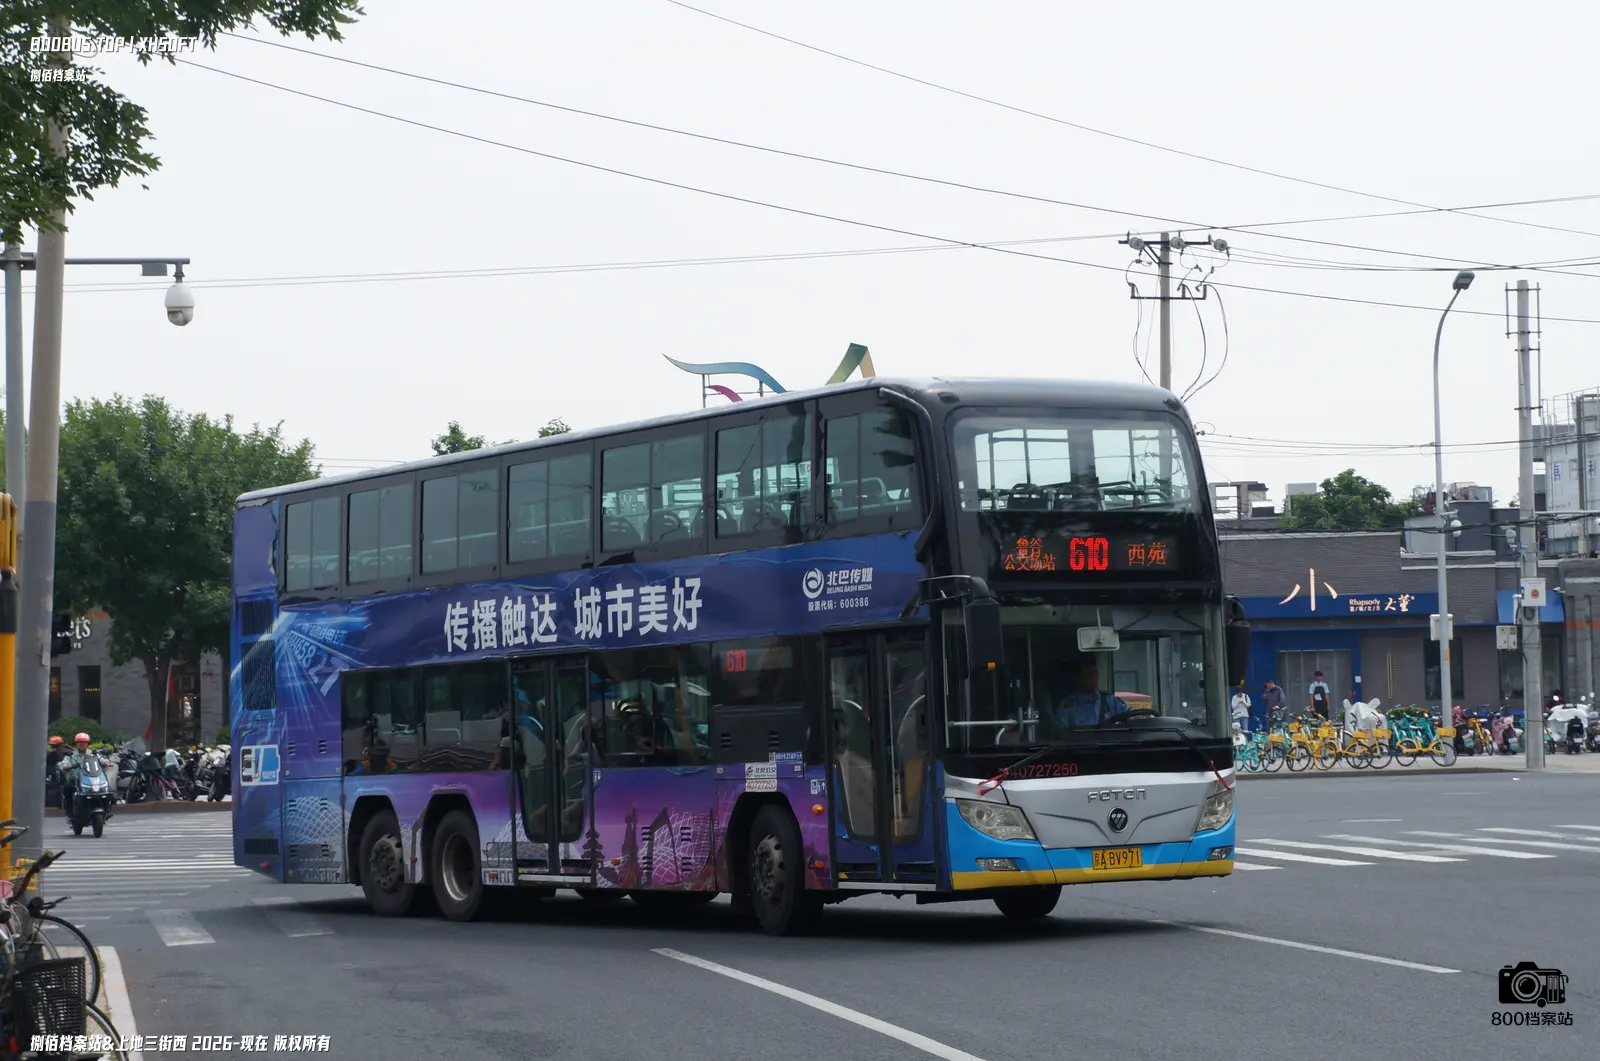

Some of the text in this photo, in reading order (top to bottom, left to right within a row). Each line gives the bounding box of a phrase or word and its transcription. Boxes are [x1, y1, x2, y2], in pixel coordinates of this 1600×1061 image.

[1069, 537, 1109, 571] 610
[1127, 542, 1167, 566] 西苑
[827, 567, 873, 586] 北巴传媒
[1279, 568, 1338, 611] 小
[443, 576, 703, 653] 传播触达 城市美好
[840, 597, 869, 609] 600386
[726, 649, 747, 672] 610
[746, 780, 776, 790] 40727250
[1088, 788, 1147, 804] FOTON
